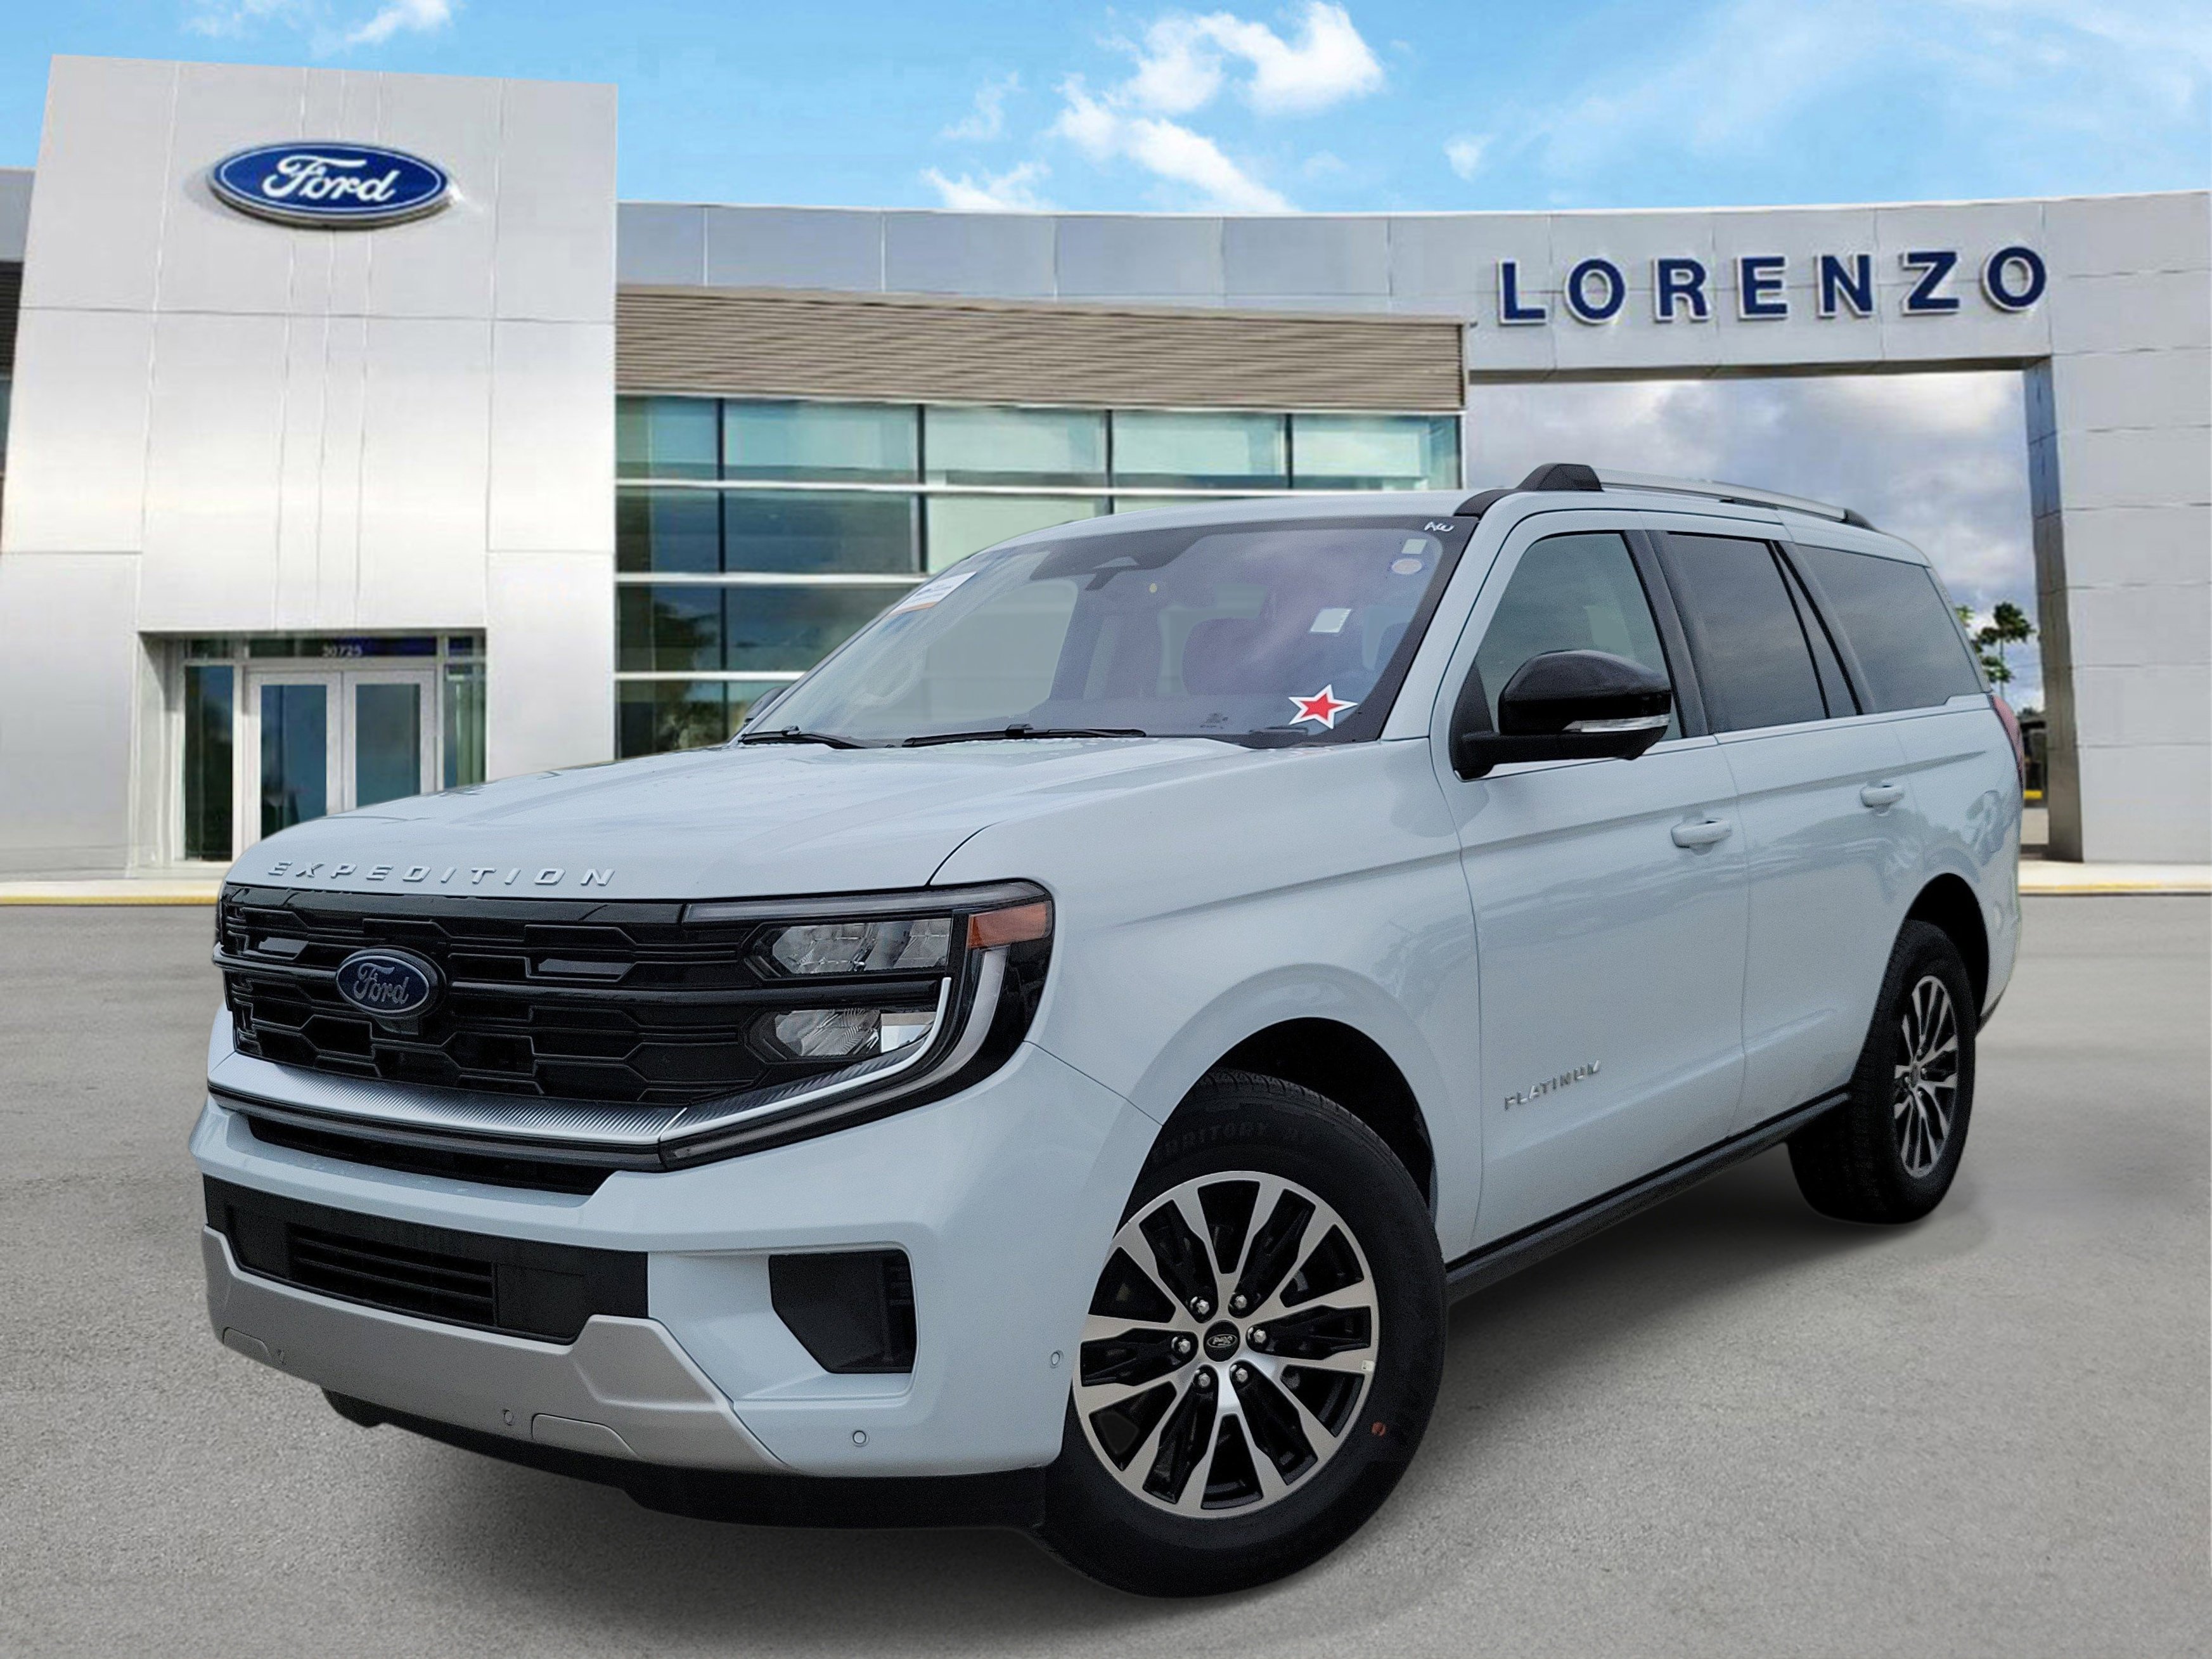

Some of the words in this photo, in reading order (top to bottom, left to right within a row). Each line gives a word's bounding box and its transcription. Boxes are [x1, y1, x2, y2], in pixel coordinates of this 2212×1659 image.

[262, 155, 401, 202] Ford
[1498, 247, 2047, 325] LORENZO
[267, 862, 616, 886] EXPEDITION
[353, 962, 409, 1005] Ford
[1504, 1059, 1601, 1111] PLATINUM
